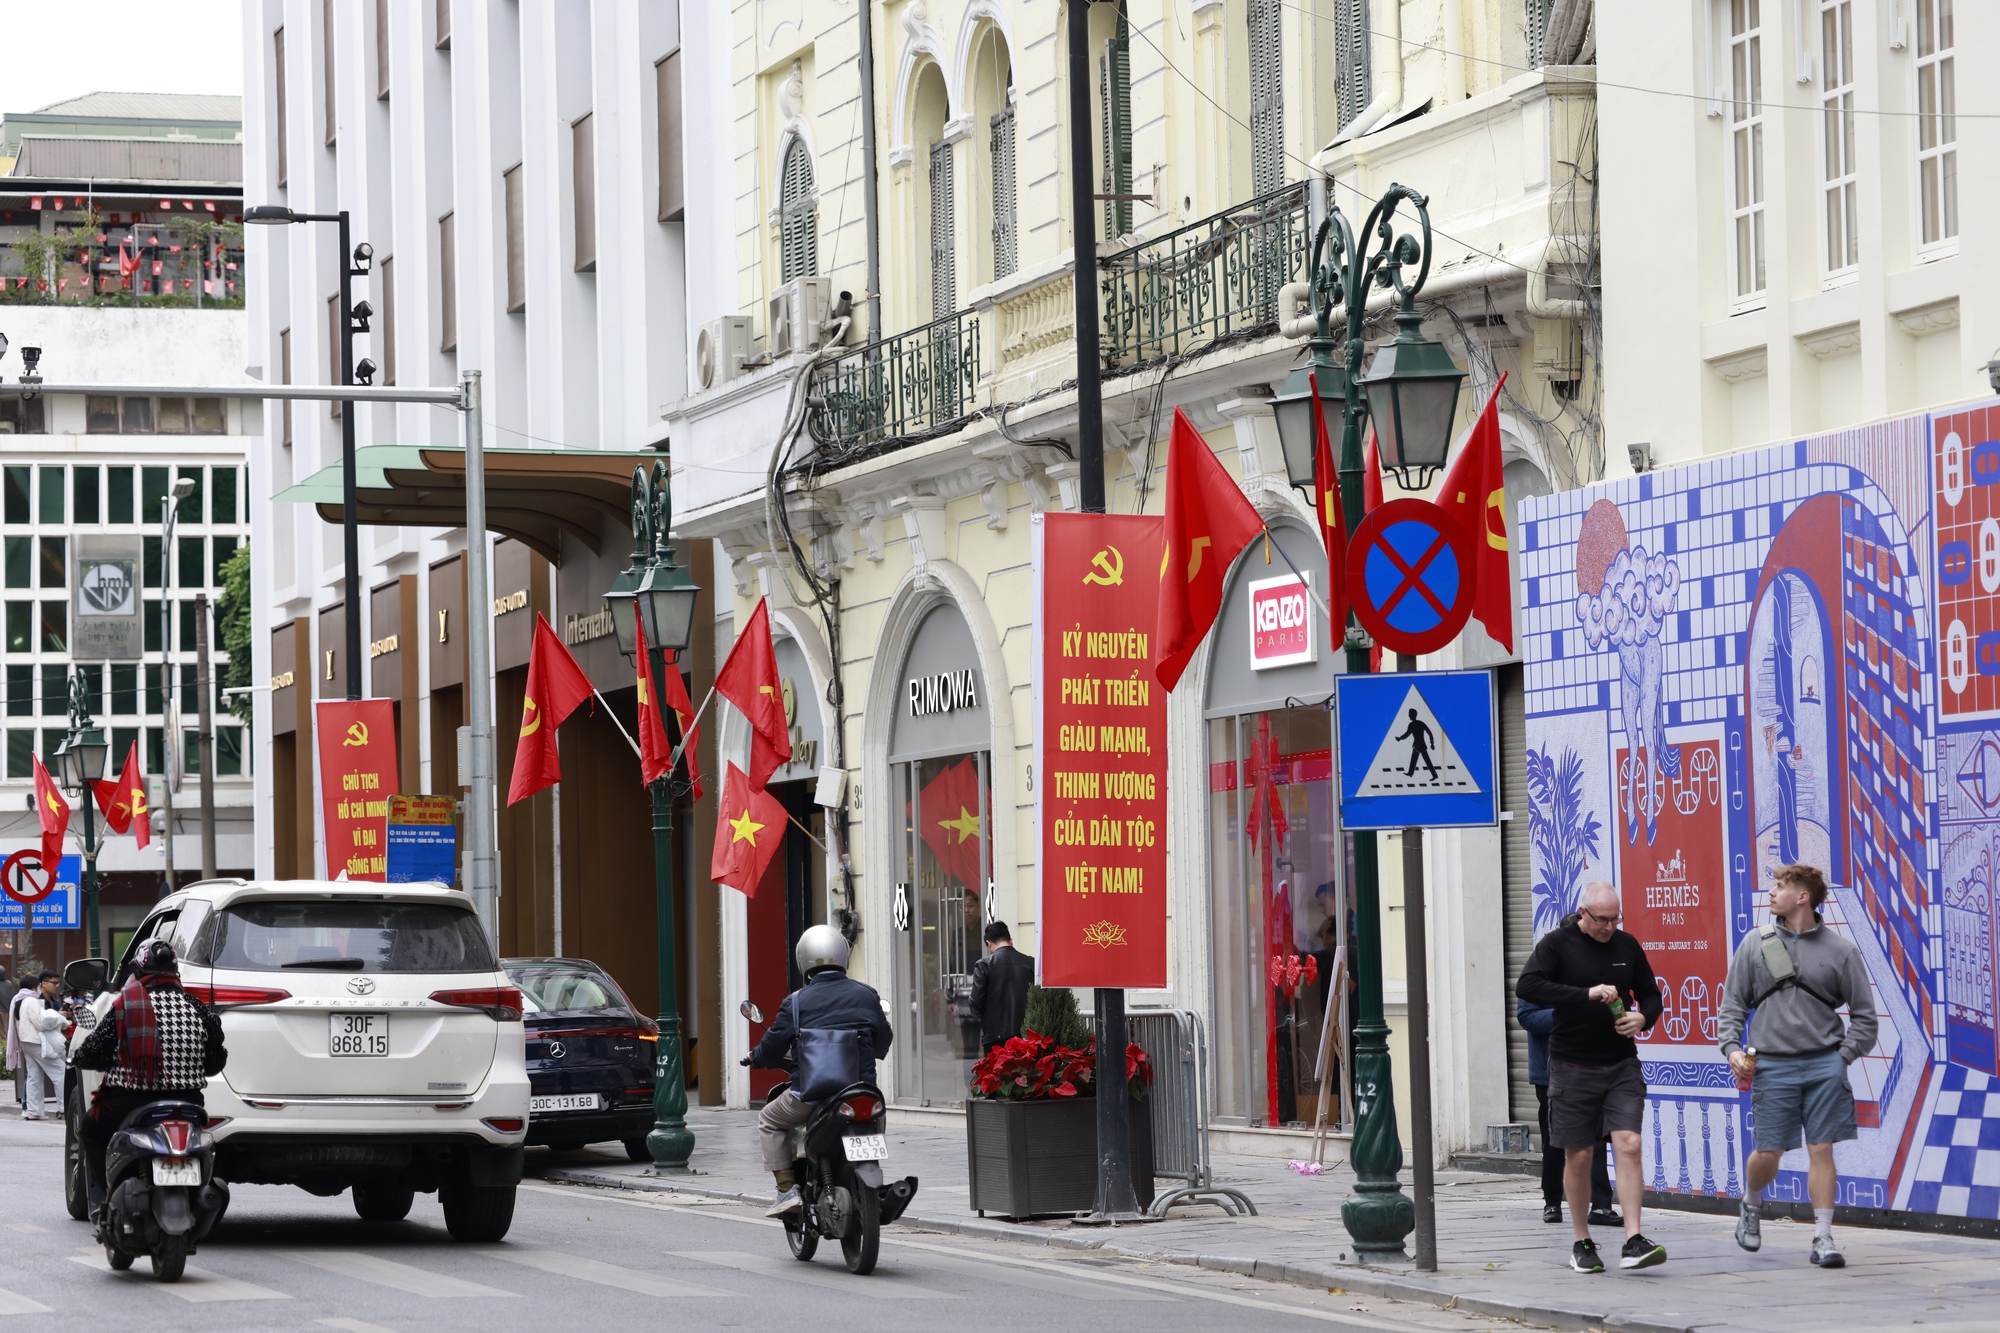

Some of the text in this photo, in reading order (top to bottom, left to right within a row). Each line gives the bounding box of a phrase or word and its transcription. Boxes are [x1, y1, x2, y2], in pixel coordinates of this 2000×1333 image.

[1256, 594, 1304, 633] KENZO
[1062, 622, 1148, 659] KỶ NGUYÊN
[1256, 630, 1304, 649] PARIS
[909, 668, 977, 717] RIMOWA
[1062, 669, 1149, 706] PHÁT TRIỂN
[783, 725, 818, 773] allery
[1060, 720, 1151, 758] GIÀU MẠNH,
[343, 769, 379, 793] CHỦ TỊCH
[1054, 771, 1156, 806] THỊNH VƯỢNG
[338, 798, 387, 819] HỒ CHÍ MINH
[353, 827, 377, 849] VĨ ĐẠI
[1054, 810, 1155, 853] CỦA DÂN TỘC
[347, 853, 369, 875] SỐNG
[1065, 861, 1143, 899] VIỆT NAM!
[1645, 883, 1700, 908] HERMÈS
[32, 914, 44, 924] ÀNG
[1662, 912, 1685, 925] PARIS
[1642, 940, 1708, 951] OPENING JANUARY 2026
[344, 1016, 374, 1034] 30F
[332, 1036, 386, 1054] 868.15
[532, 1096, 593, 1110] 30C-131.68
[849, 1136, 880, 1148] 29-L5
[847, 1147, 887, 1160] 245.28
